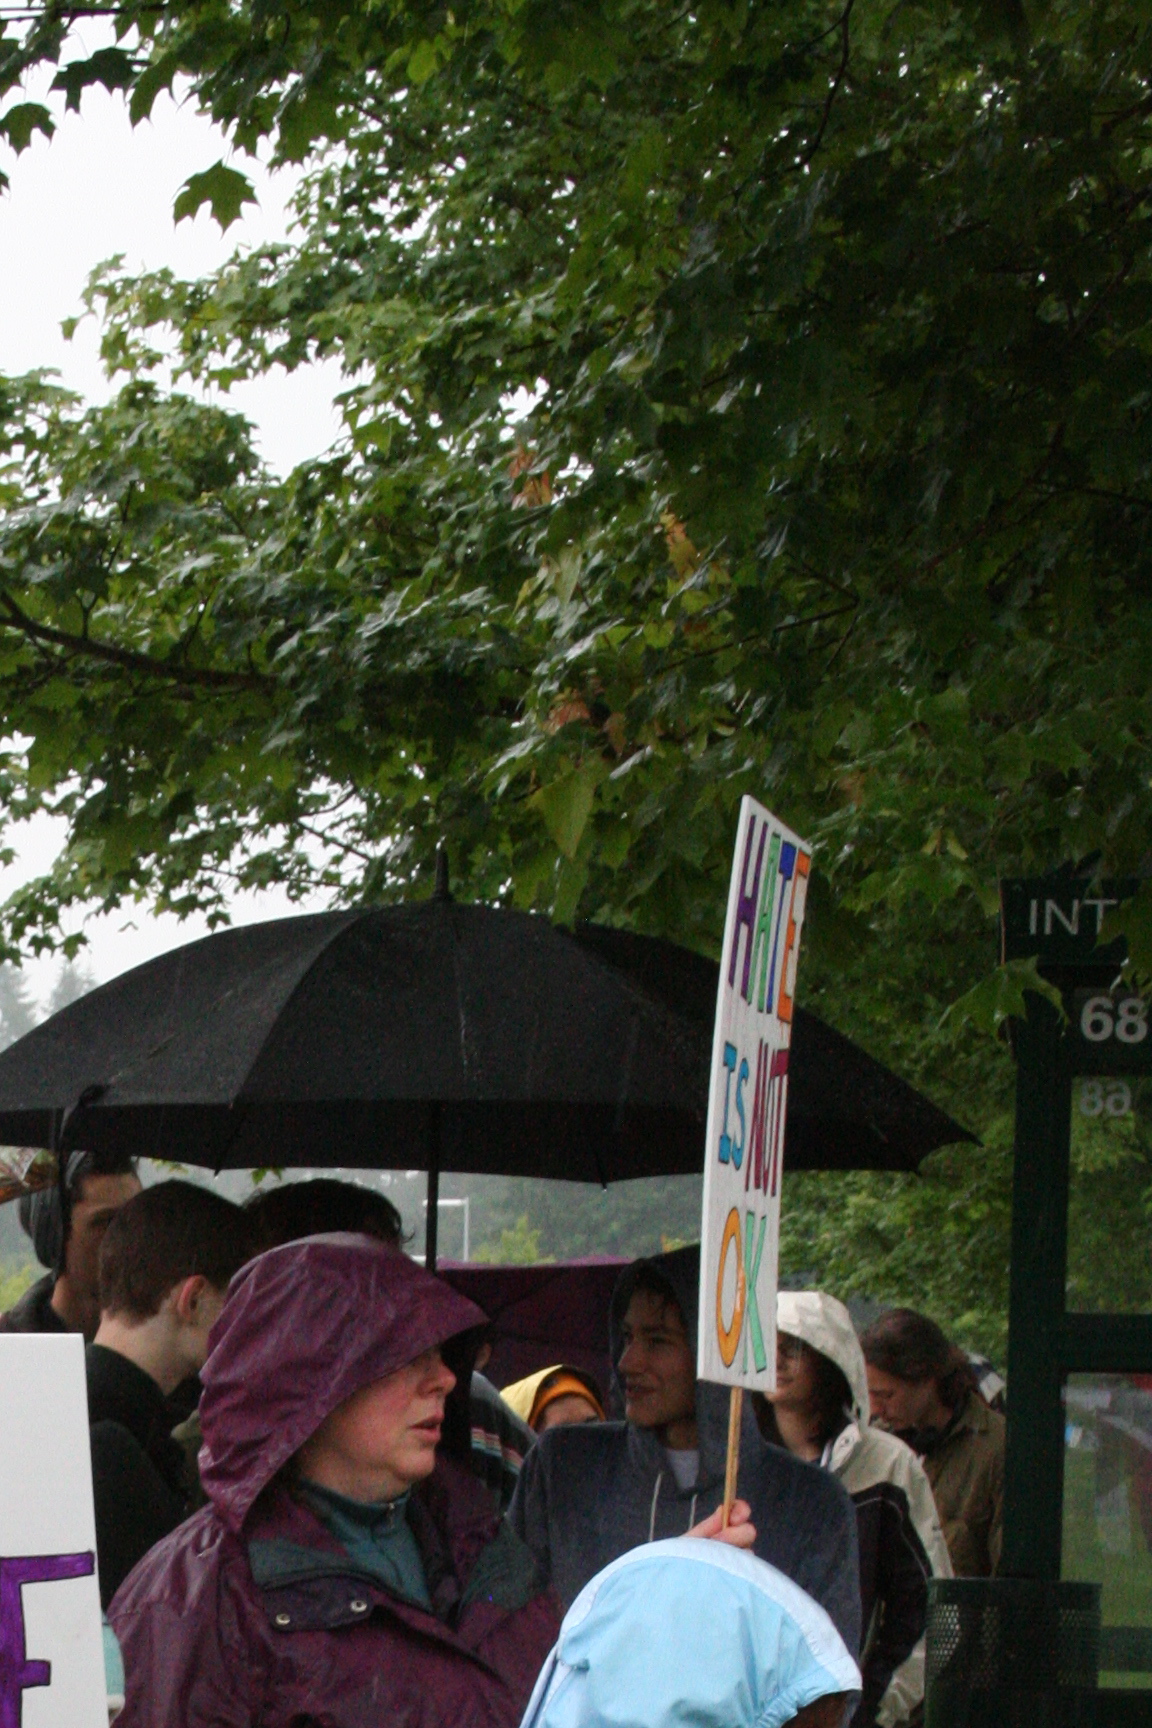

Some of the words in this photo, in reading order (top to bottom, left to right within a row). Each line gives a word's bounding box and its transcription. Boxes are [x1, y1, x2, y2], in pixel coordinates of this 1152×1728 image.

[728, 814, 812, 1025] HATE
[1079, 996, 1149, 1044] 68
[717, 1040, 749, 1171] IS
[744, 1036, 790, 1198] NOT
[715, 1205, 768, 1376] OK
